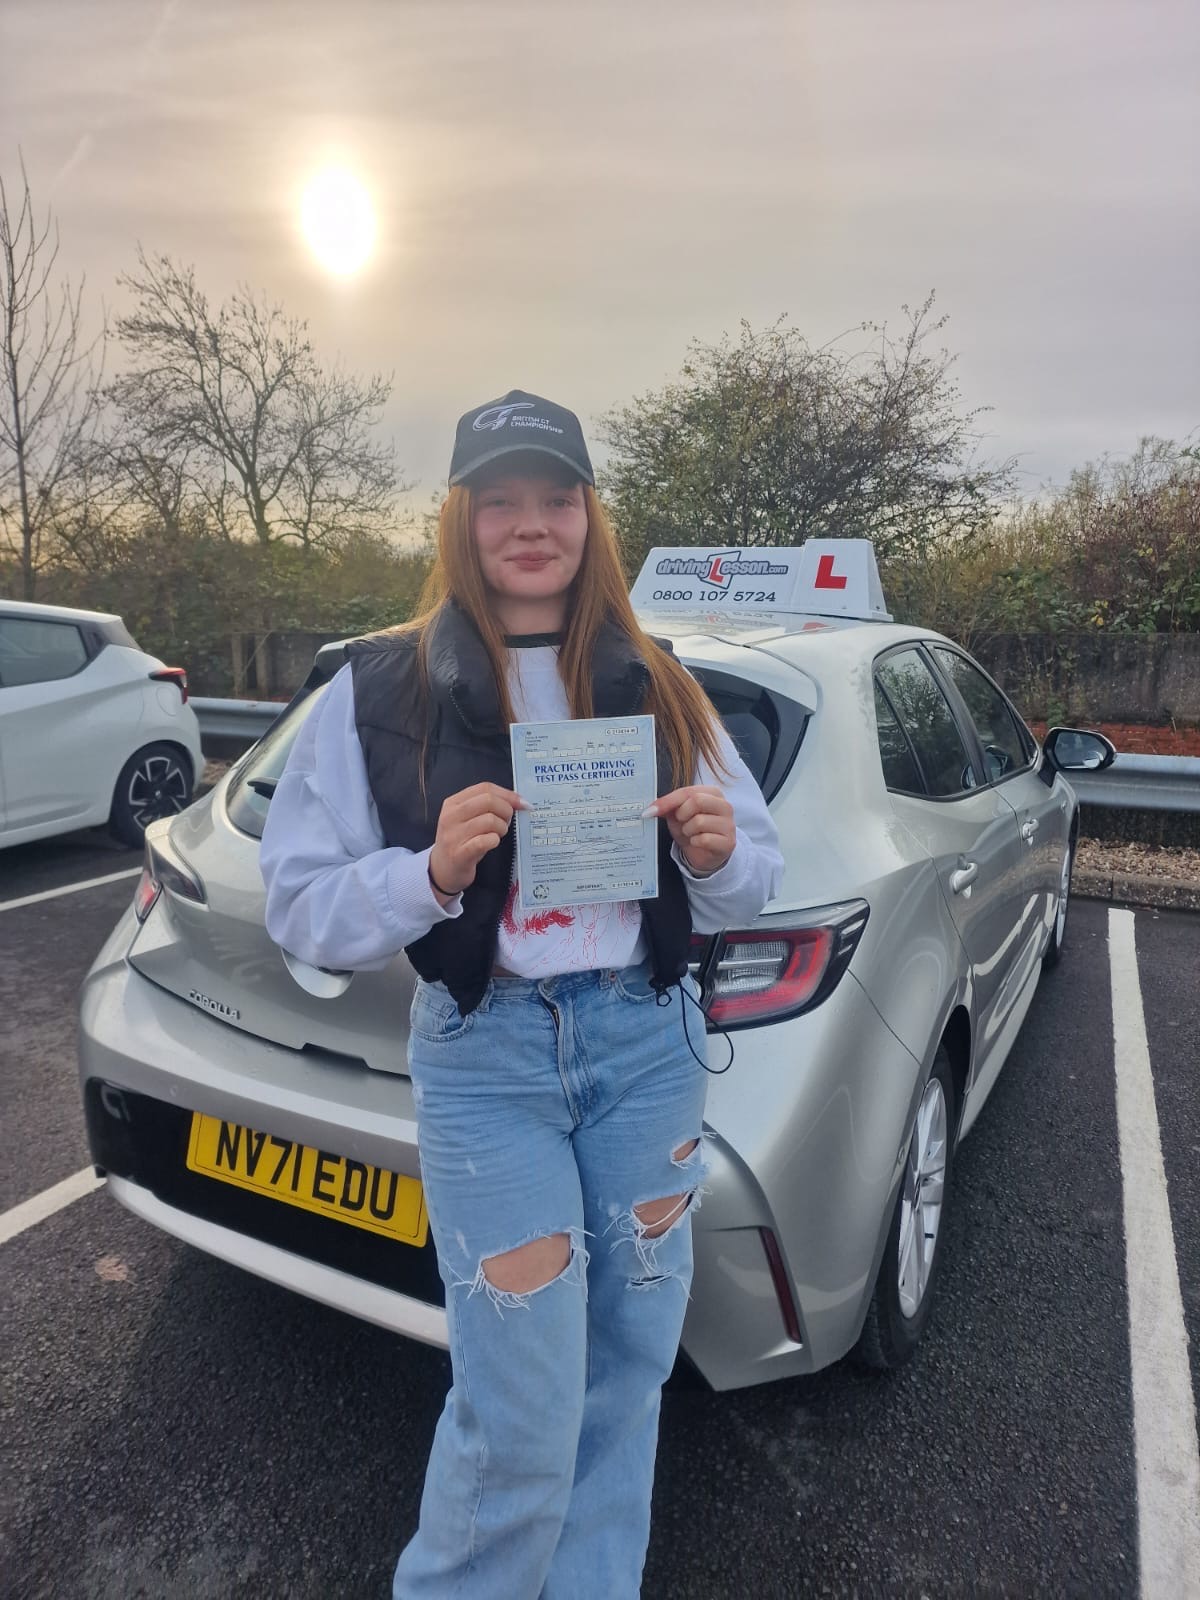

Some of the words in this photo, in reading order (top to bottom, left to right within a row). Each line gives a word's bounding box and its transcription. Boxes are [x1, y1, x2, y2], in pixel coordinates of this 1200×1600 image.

[511, 415, 540, 423] BRITISH
[510, 421, 564, 434] CHAMPIONSHIP
[814, 555, 848, 590] L
[652, 590, 693, 601] 0800
[699, 591, 728, 602] 107
[733, 591, 777, 602] 5724
[534, 762, 587, 774] PRACTICAL
[591, 759, 635, 770] DRIVING
[535, 774, 555, 783] TEST
[558, 773, 579, 782] PASS
[581, 769, 635, 780] CERTIFICATE
[190, 988, 241, 1020] COROLLA
[215, 1120, 305, 1192] NV71
[312, 1150, 399, 1221] EDU
